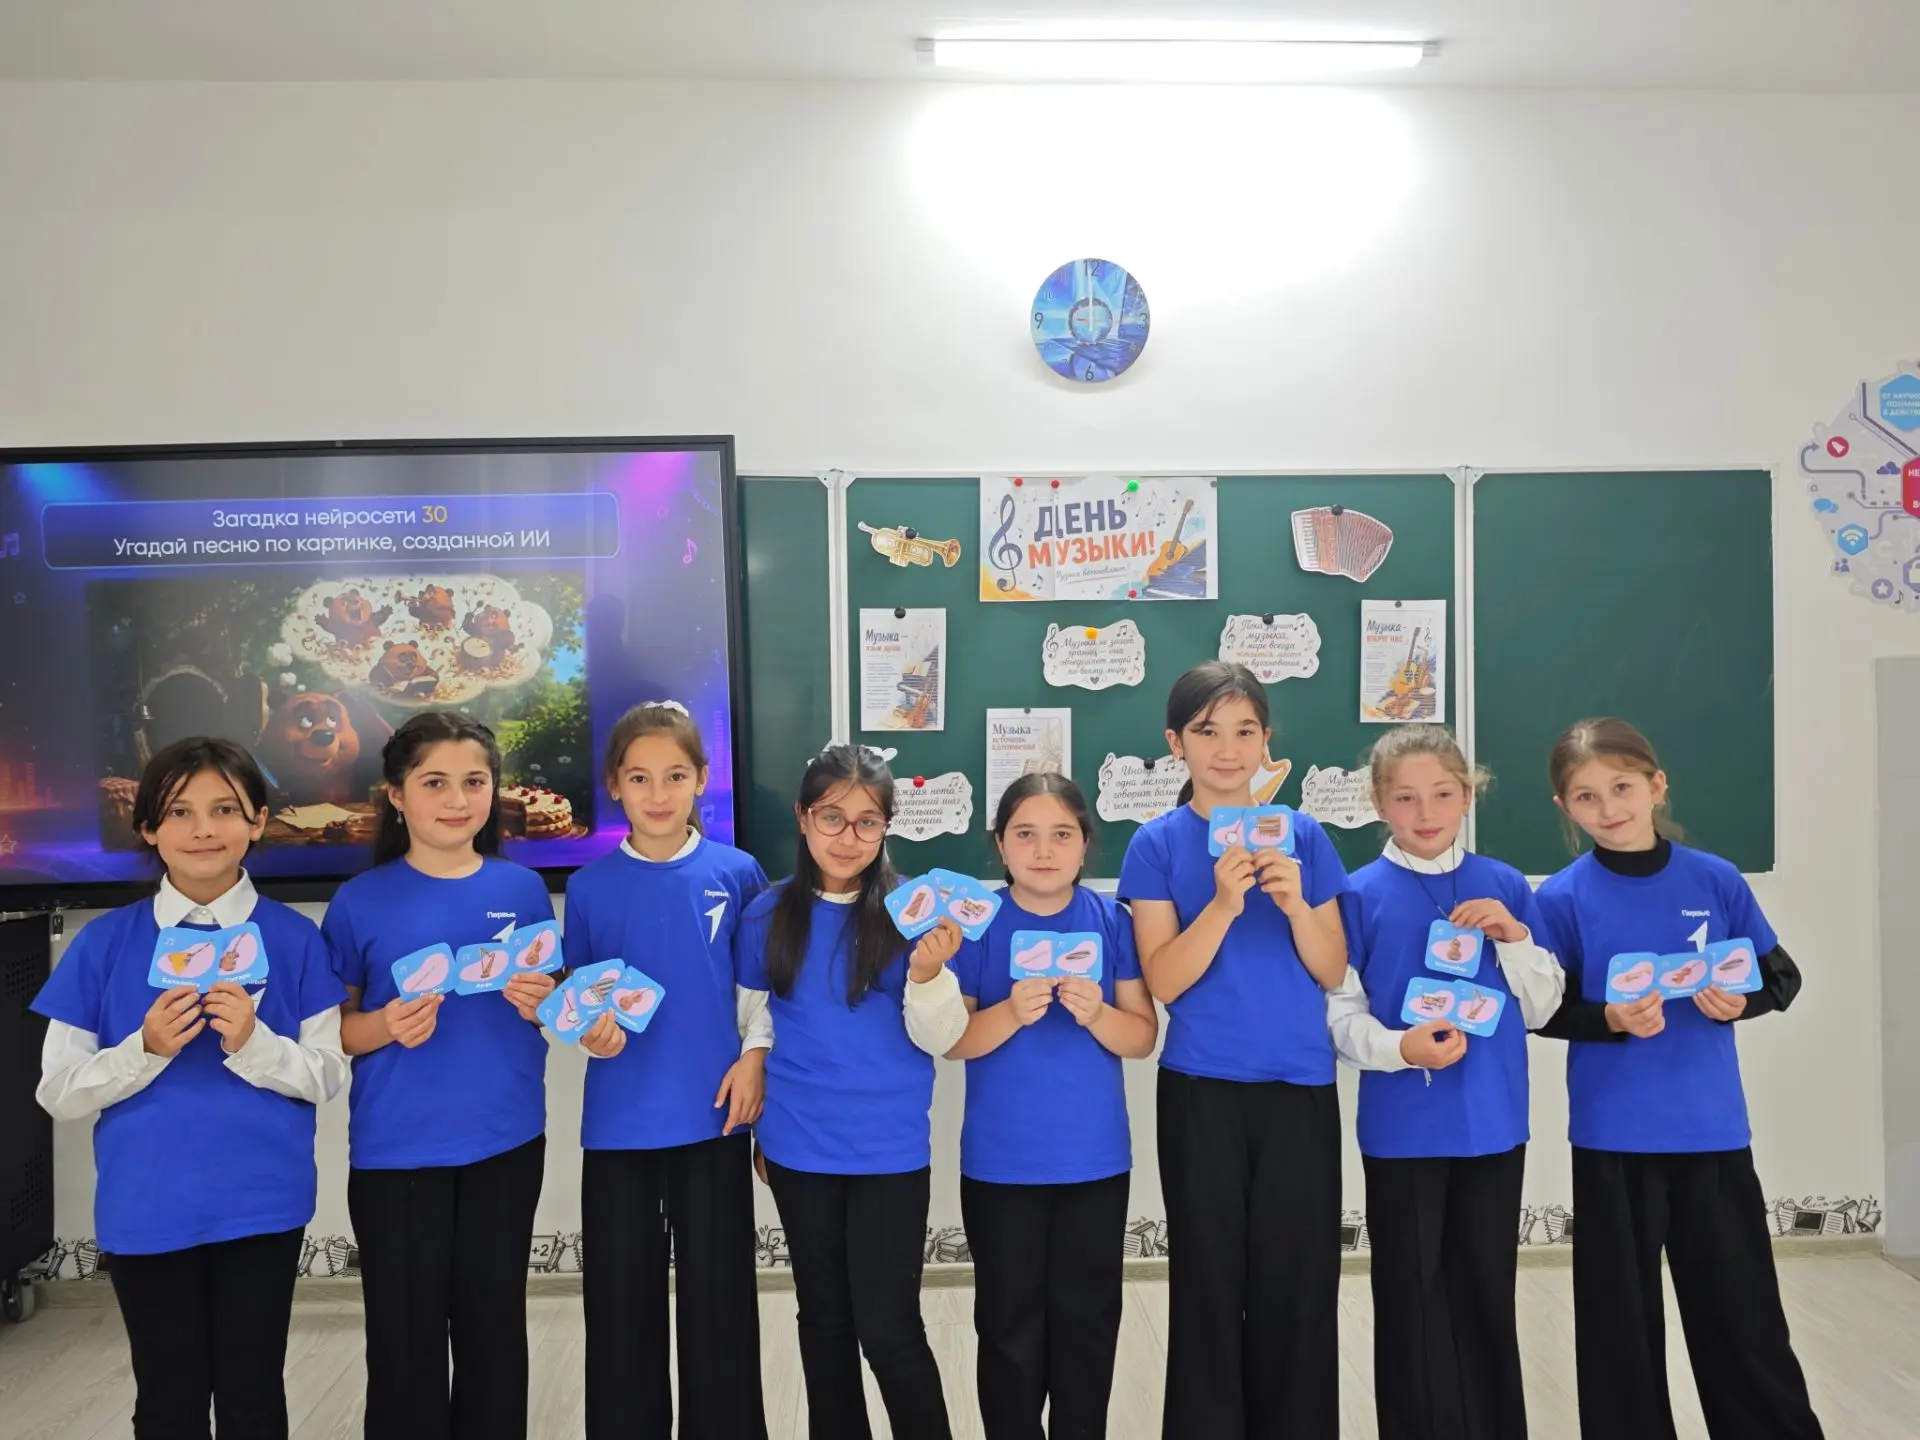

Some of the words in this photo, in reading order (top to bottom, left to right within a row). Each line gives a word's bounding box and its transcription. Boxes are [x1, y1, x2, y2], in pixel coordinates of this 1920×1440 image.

[1034, 312, 1044, 329] 9
[1085, 362, 1094, 381] 6
[213, 510, 298, 529] Загадка
[305, 508, 416, 528] нейросети
[422, 505, 448, 523] 30
[1034, 499, 1127, 542] ДЕНЬ
[113, 538, 187, 557] Угадай
[194, 539, 260, 554] песню
[265, 539, 291, 552] по
[296, 534, 397, 555] картинке,
[402, 531, 515, 551] созданной
[521, 530, 550, 547] ИИ
[1028, 530, 1155, 569] МУЗЫКИ!
[1366, 619, 1401, 635] Музыка
[866, 629, 899, 645] Музыка
[992, 723, 1031, 737] Музыка
